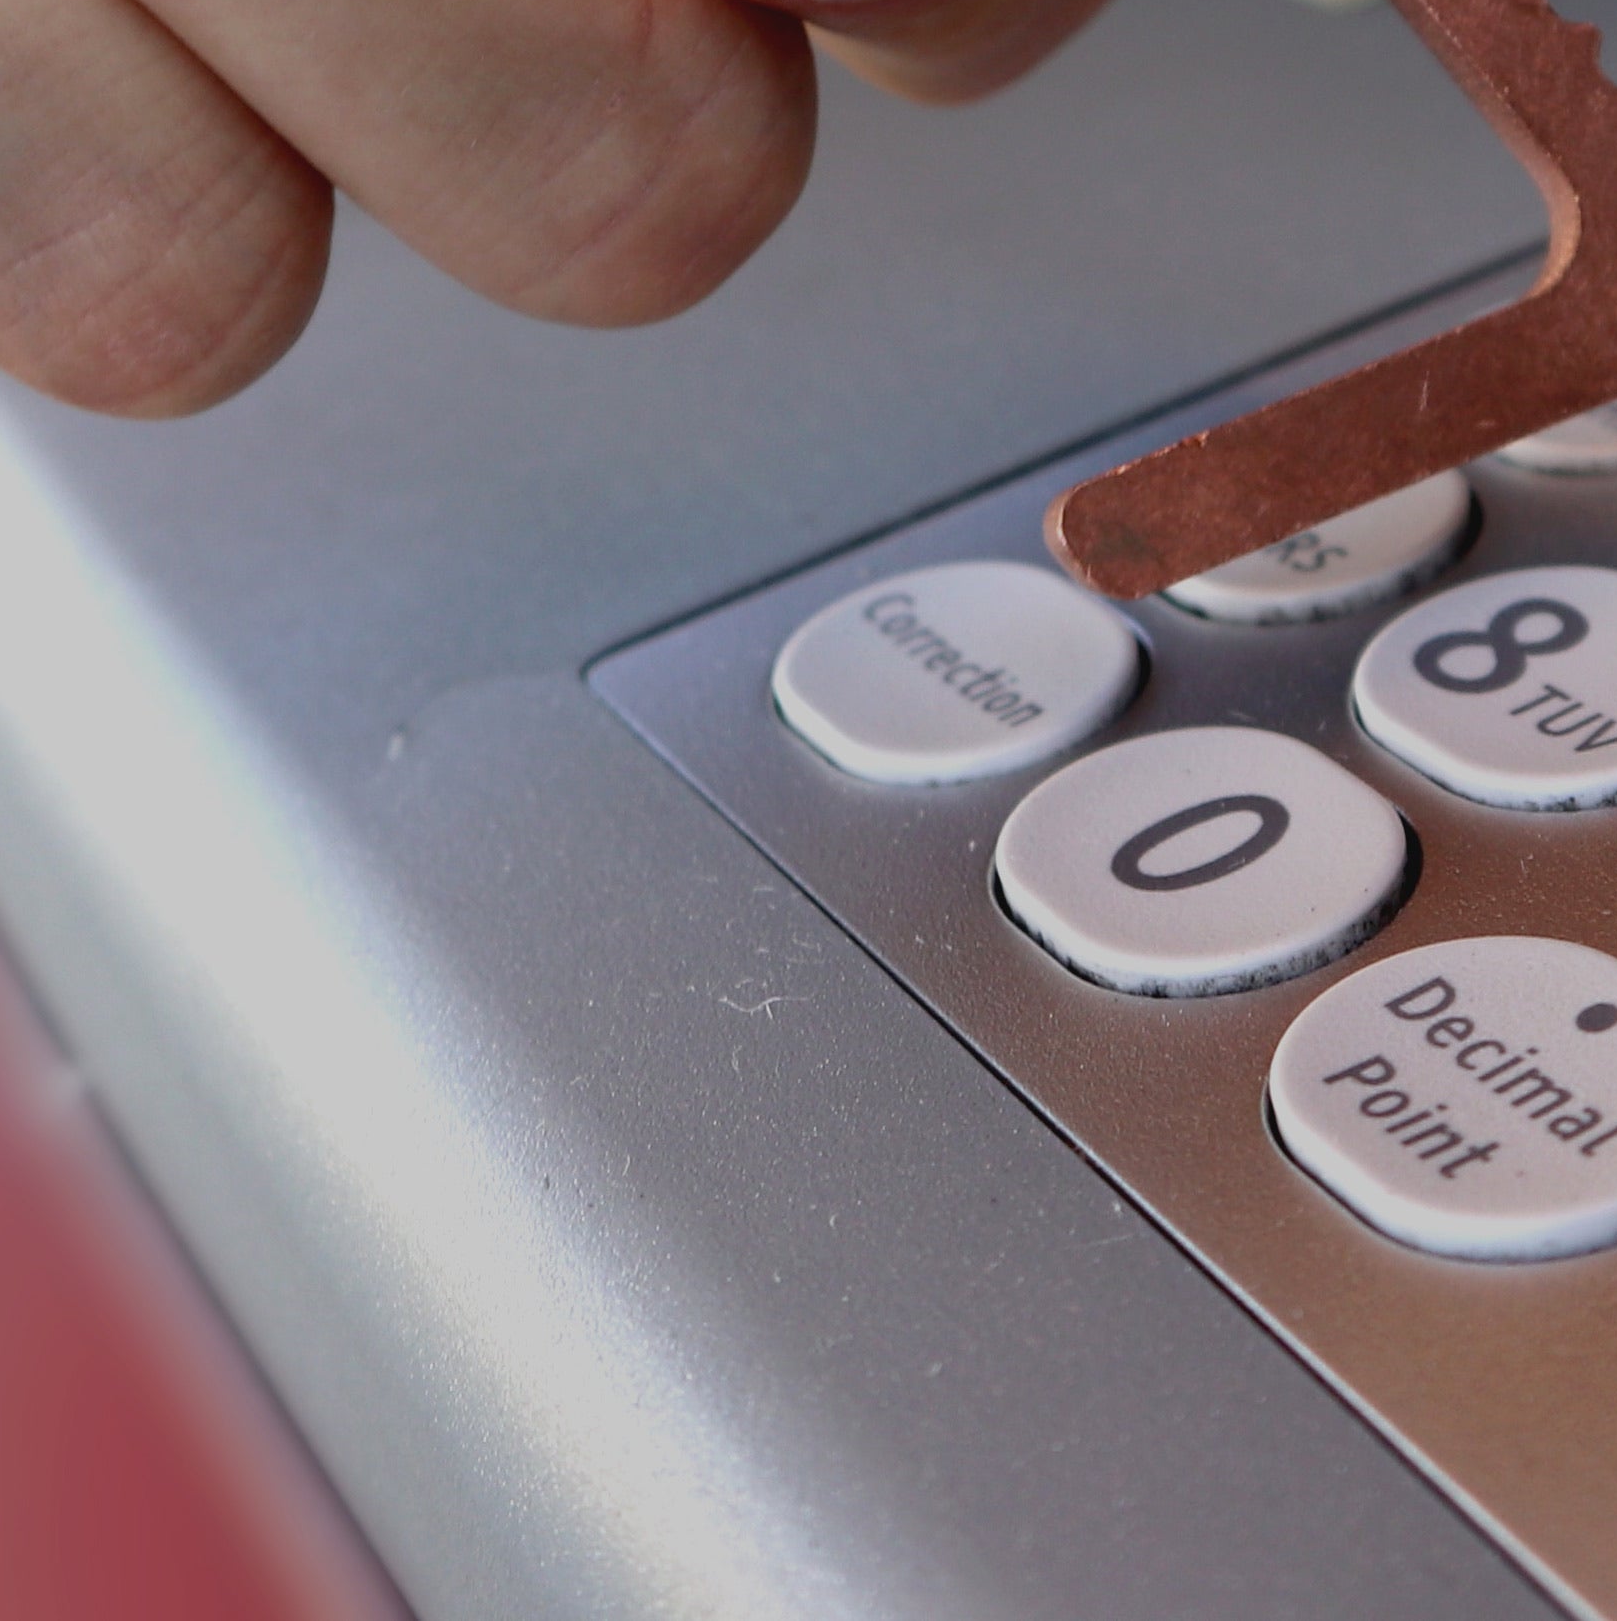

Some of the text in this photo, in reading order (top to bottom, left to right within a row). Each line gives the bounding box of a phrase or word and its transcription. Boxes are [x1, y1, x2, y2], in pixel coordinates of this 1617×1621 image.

[1266, 532, 1349, 573] RS
[861, 592, 1044, 729] Correction
[1412, 597, 1590, 696] 8
[1111, 794, 1290, 891] 0
[1323, 1055, 1503, 1180] Point
